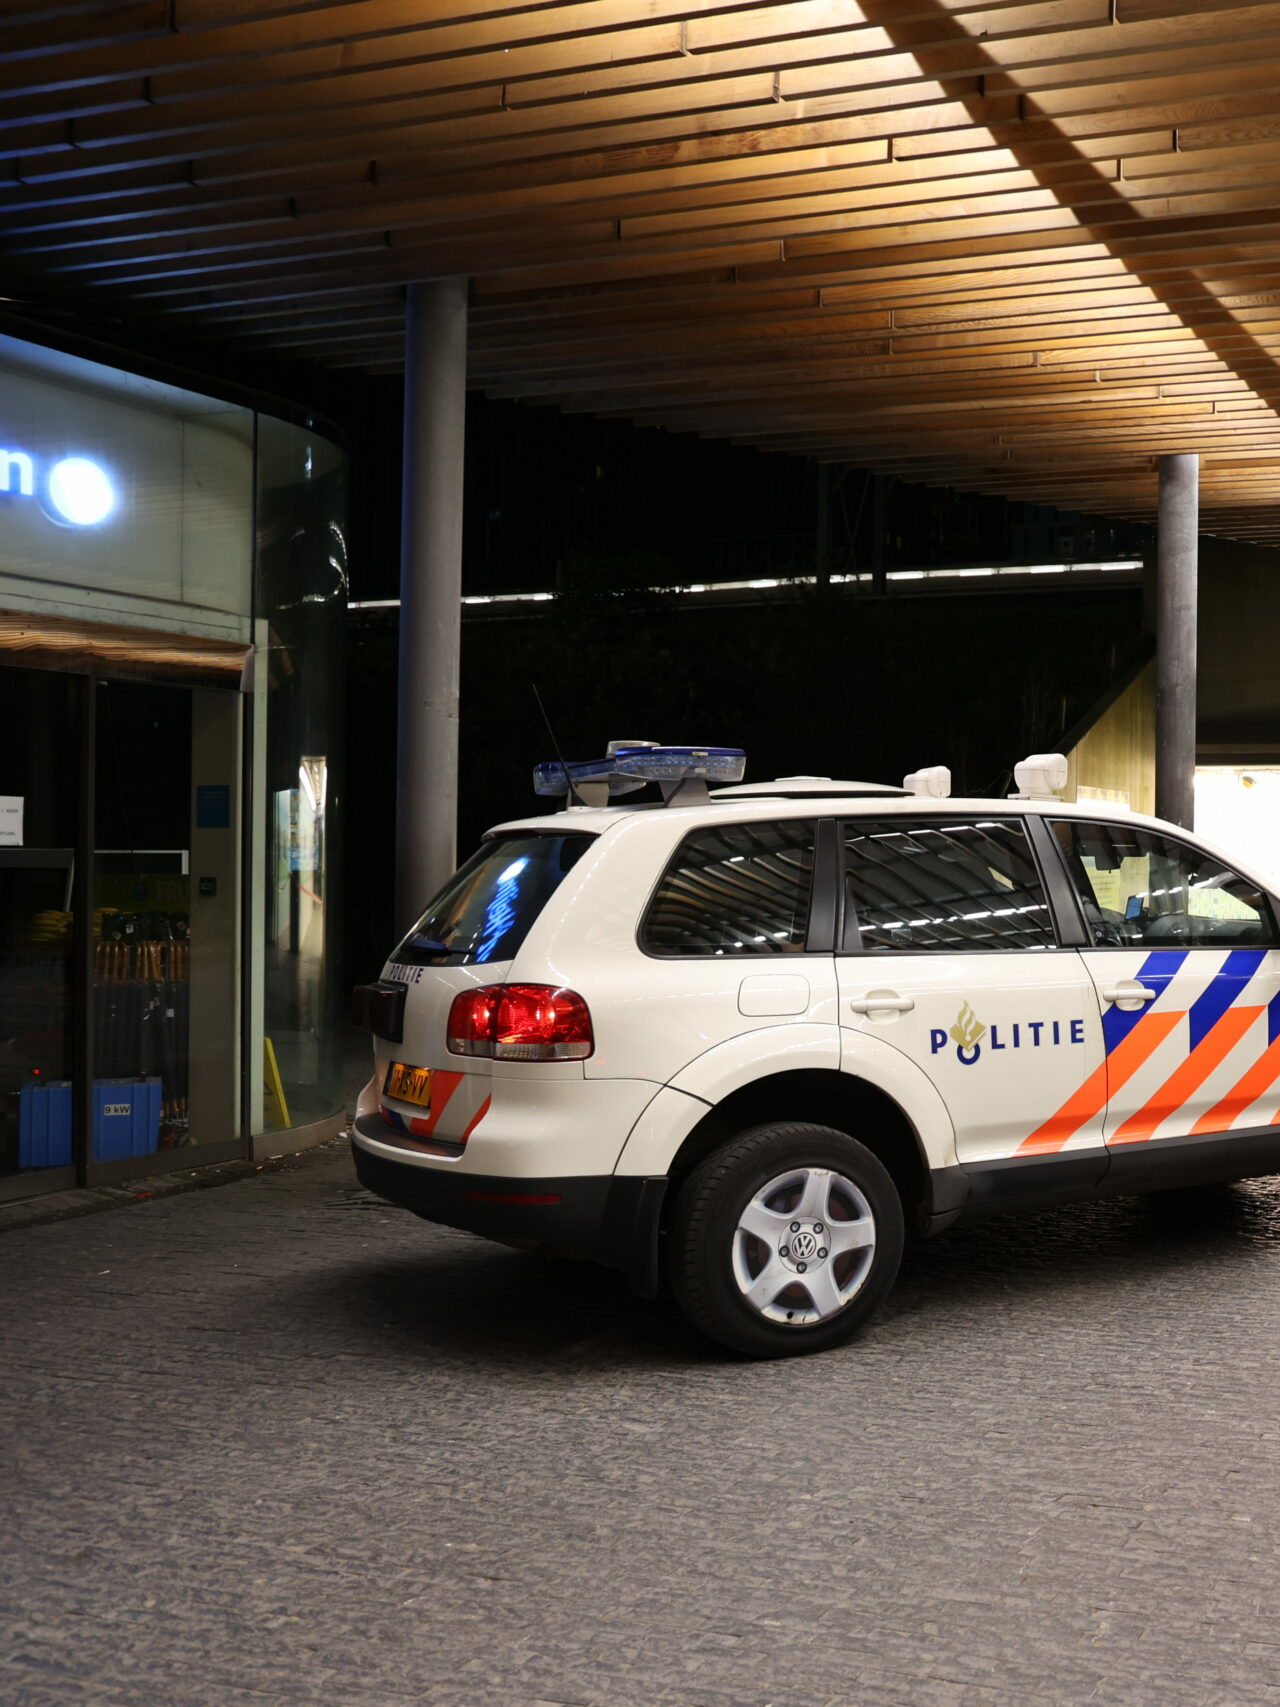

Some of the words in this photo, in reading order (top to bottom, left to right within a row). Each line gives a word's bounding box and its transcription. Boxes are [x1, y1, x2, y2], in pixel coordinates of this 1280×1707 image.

[389, 964, 424, 984] POLITIE
[930, 1019, 1084, 1065] POLITIE
[104, 1105, 111, 1114] 9
[113, 1105, 130, 1114] kW
